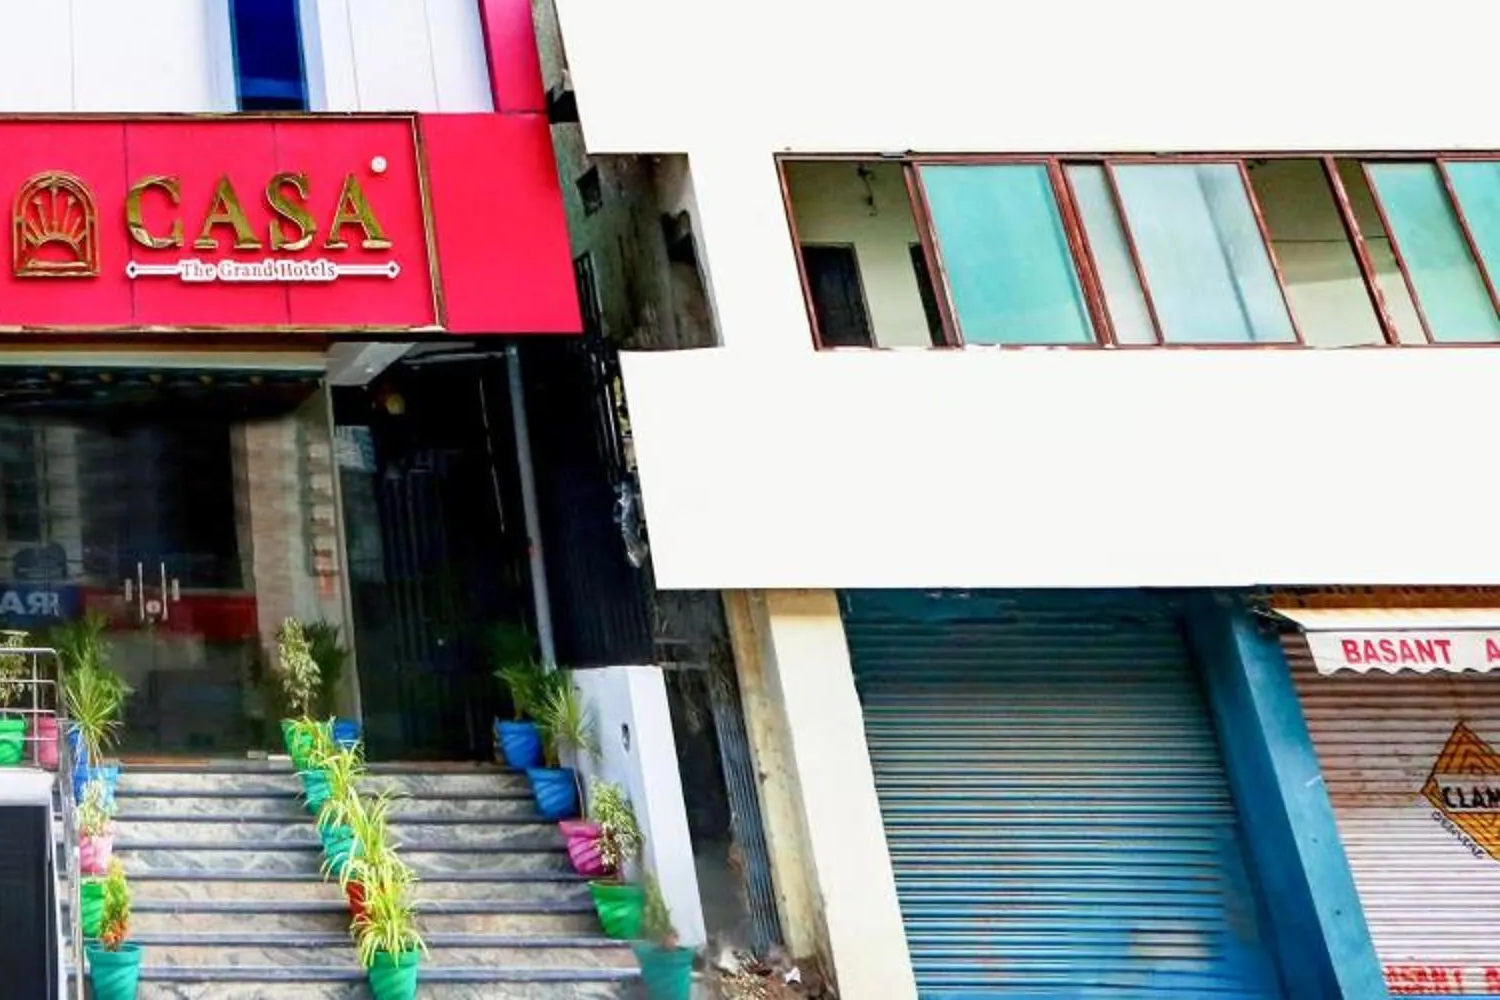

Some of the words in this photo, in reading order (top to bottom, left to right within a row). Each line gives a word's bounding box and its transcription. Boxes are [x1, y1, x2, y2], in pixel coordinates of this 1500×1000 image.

[126, 171, 394, 251] CASA
[180, 260, 215, 279] The
[218, 259, 276, 280] Grand
[278, 259, 337, 279] Hotels
[1341, 638, 1453, 666] BASANT
